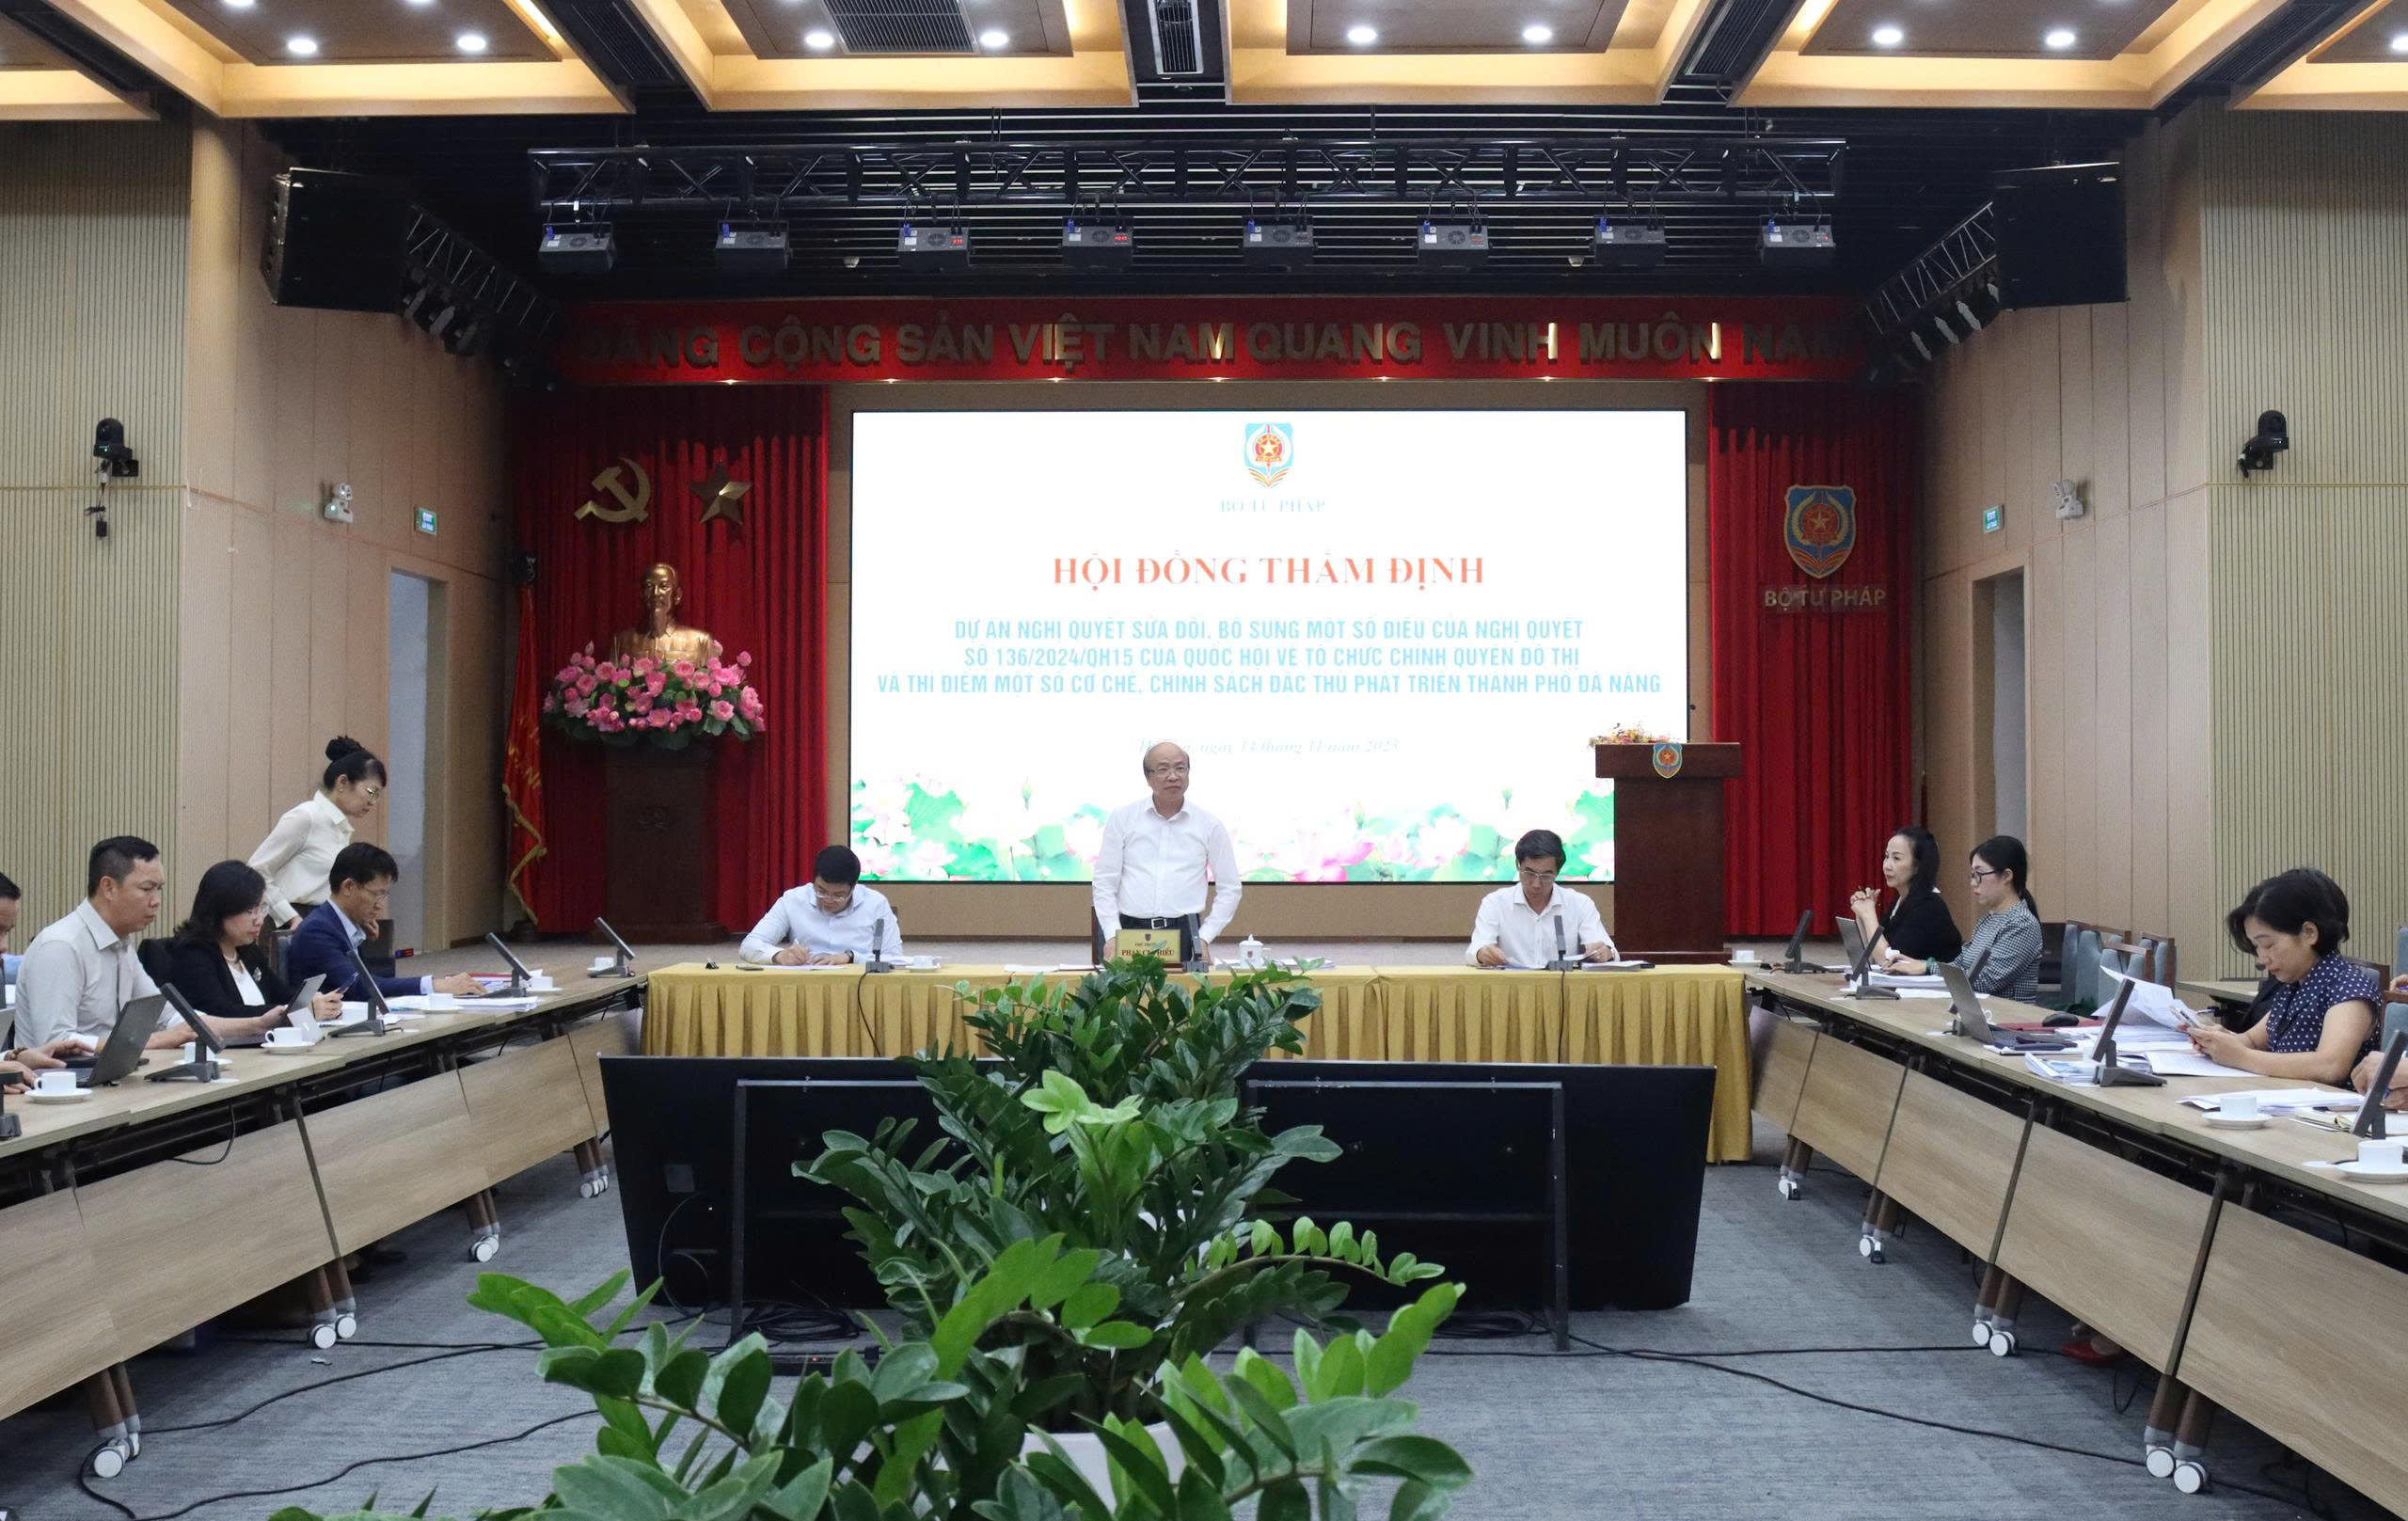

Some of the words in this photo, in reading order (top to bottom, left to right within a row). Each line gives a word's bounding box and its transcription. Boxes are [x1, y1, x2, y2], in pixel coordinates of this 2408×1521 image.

[740, 316, 880, 372] CỘNG
[1008, 312, 1116, 372] VIỆT
[1128, 324, 1233, 363] NAM
[1247, 322, 1421, 362] QUANG
[1443, 323, 1558, 361] VINH
[1579, 312, 1721, 363] MUÔN
[1054, 551, 1121, 592] HỘI
[1135, 549, 1247, 584] ĐỒNG
[1386, 557, 1483, 593] ĐỊNH
[1765, 587, 1792, 611] BỘ
[1796, 588, 1826, 607] TƯ
[1831, 586, 1887, 607] PHÁP
[1249, 620, 1300, 640] SUNG
[996, 647, 1133, 667] 136/2024/QH15
